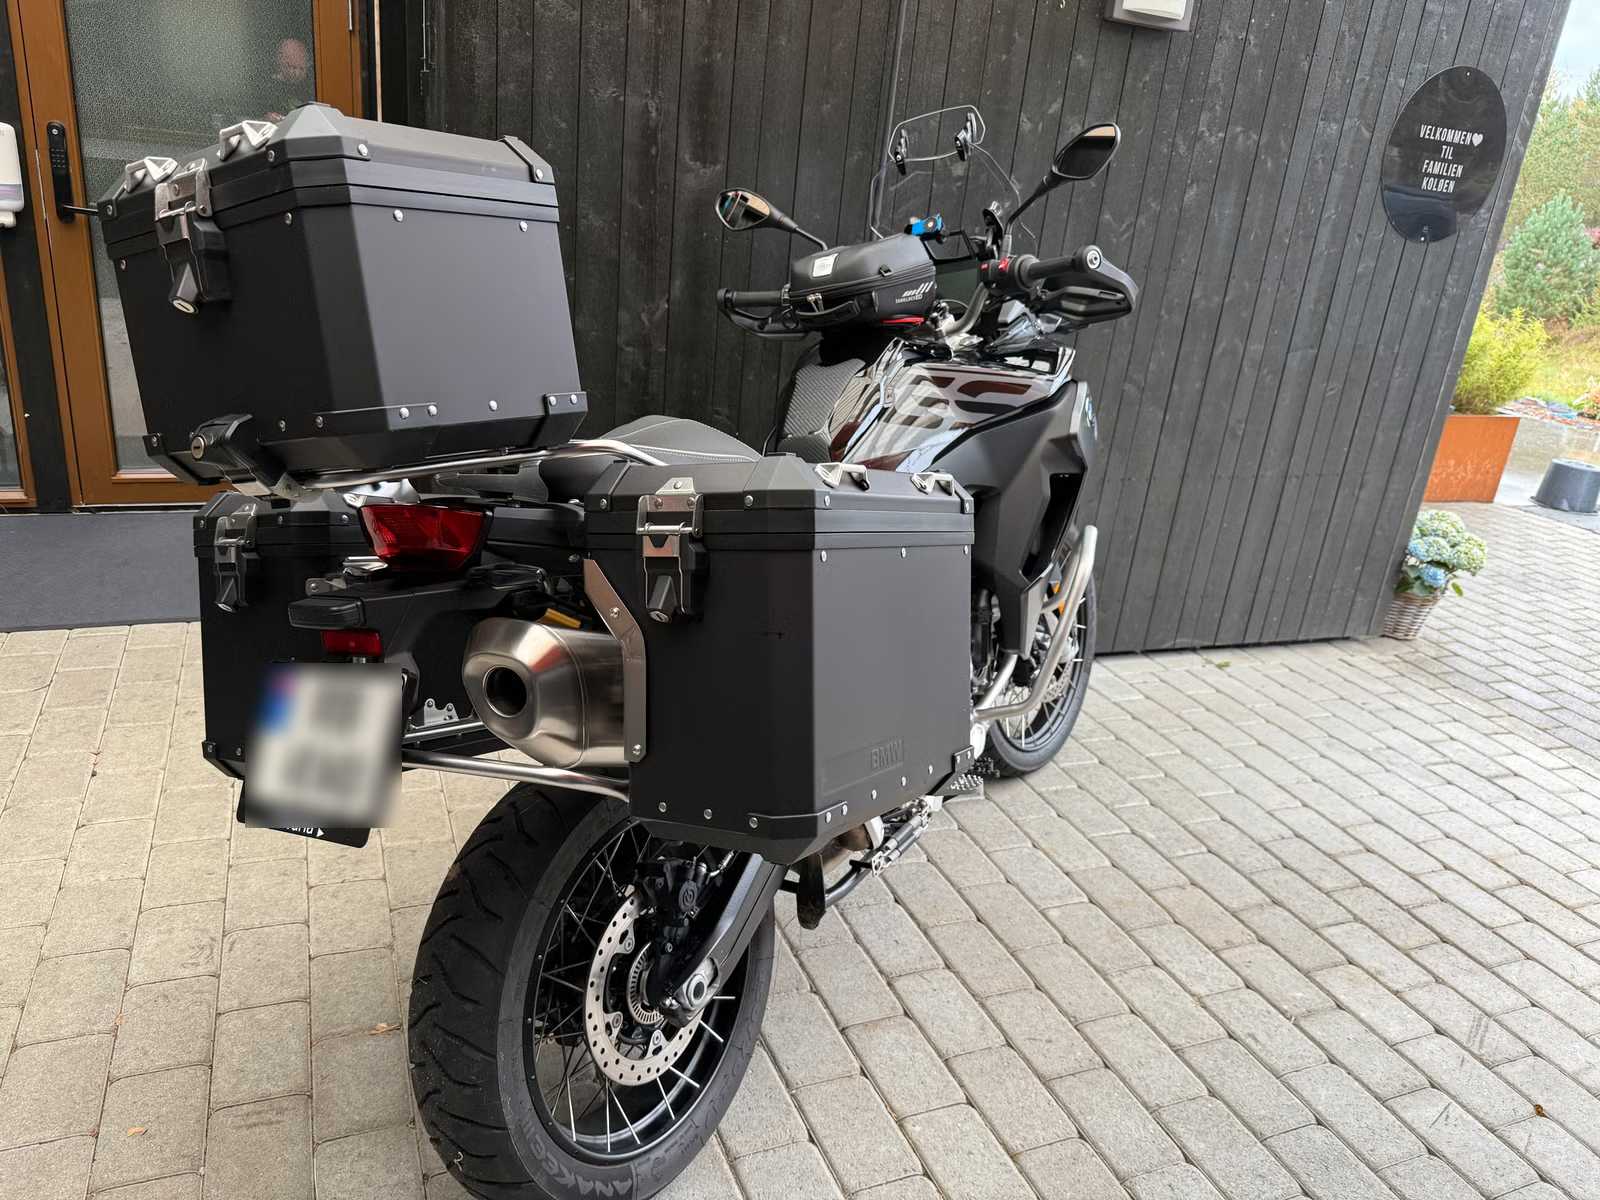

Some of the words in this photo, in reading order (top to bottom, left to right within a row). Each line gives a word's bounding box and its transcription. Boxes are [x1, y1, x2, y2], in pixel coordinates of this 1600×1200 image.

[1420, 124, 1472, 145] VELKOMMEN
[1441, 145, 1454, 160] TIL
[1422, 160, 1464, 178] FAMILIEN
[1421, 177, 1456, 193] KOLØEN
[871, 740, 902, 768] BMW
